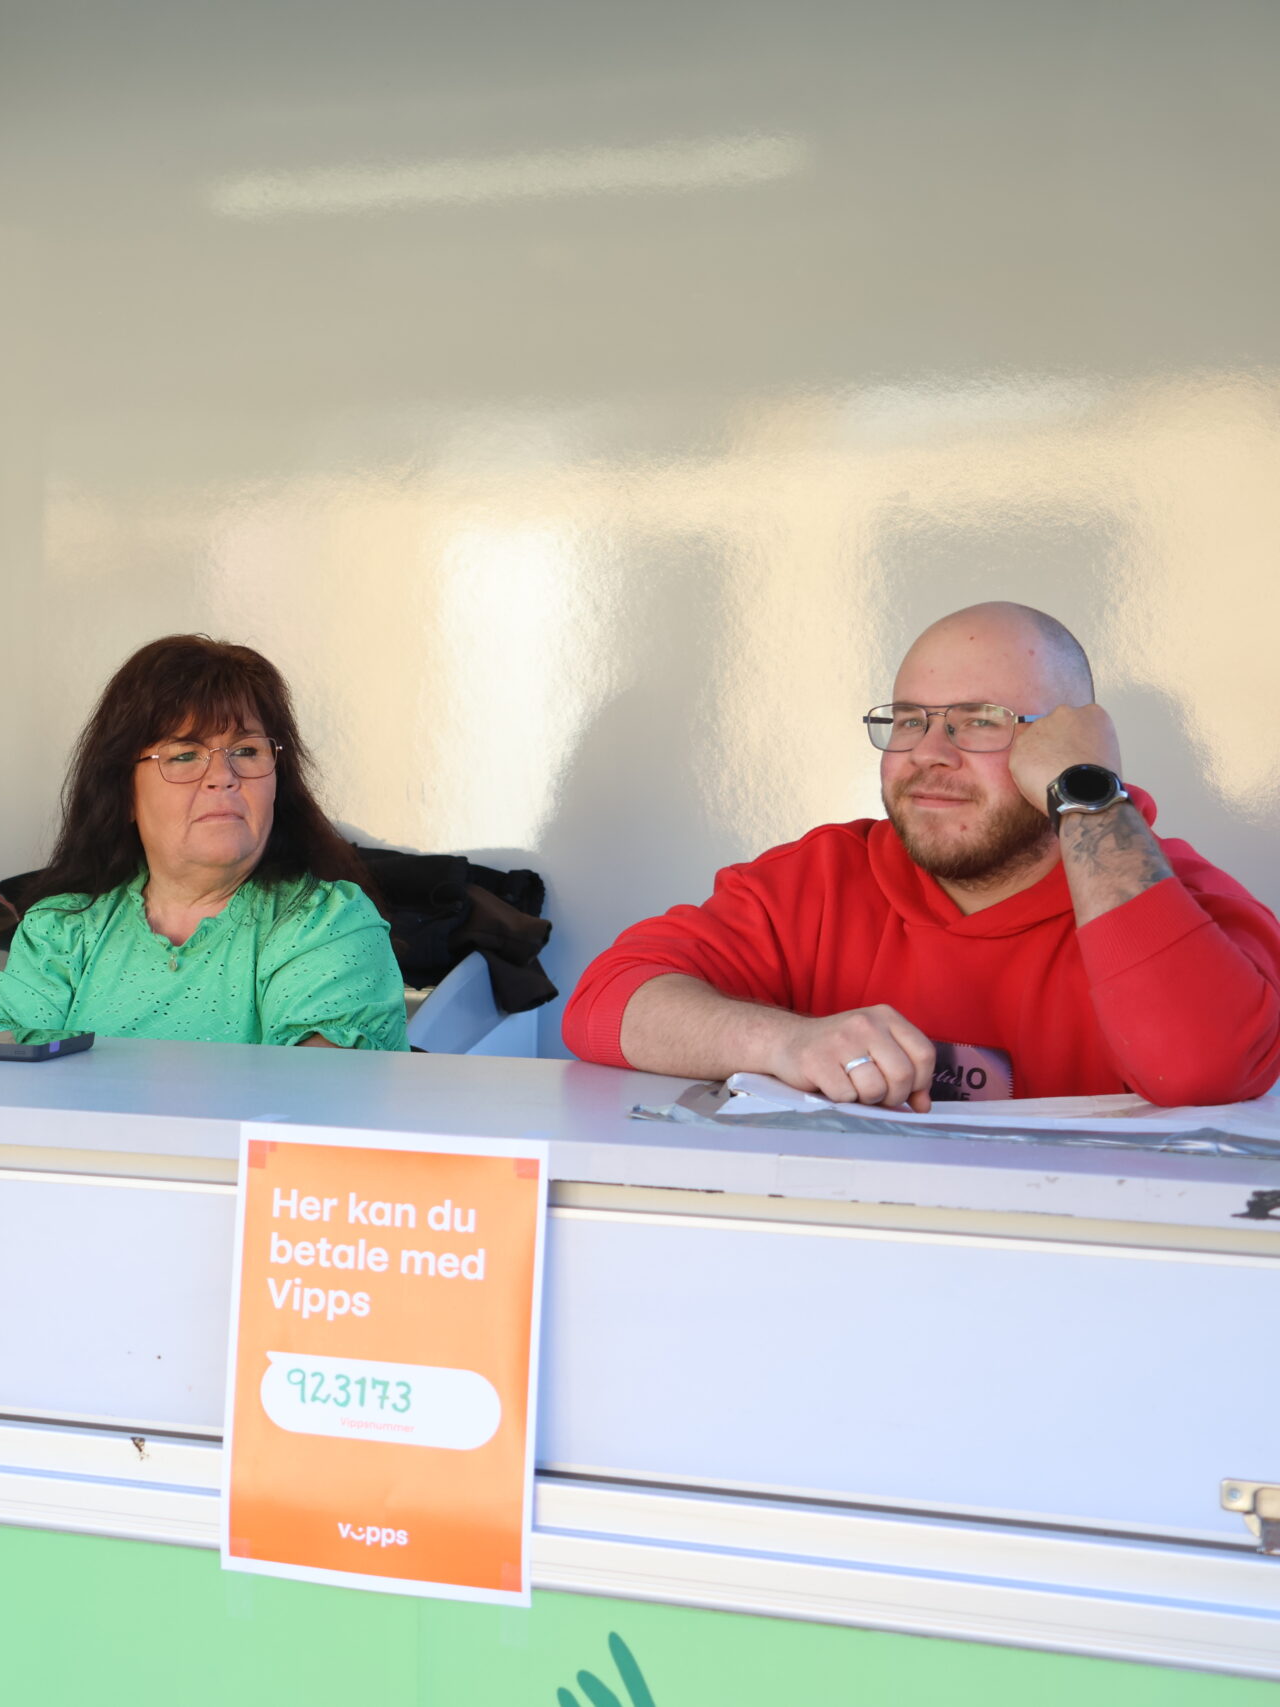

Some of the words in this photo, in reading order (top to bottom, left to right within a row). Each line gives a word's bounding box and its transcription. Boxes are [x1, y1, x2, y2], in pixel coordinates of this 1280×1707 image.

[271, 1187, 338, 1222] Her
[347, 1192, 417, 1228] kan
[427, 1199, 477, 1233] du
[268, 1232, 390, 1272] betale
[399, 1248, 487, 1281] med
[266, 1277, 372, 1321] Vipps
[286, 1368, 413, 1414] 923173
